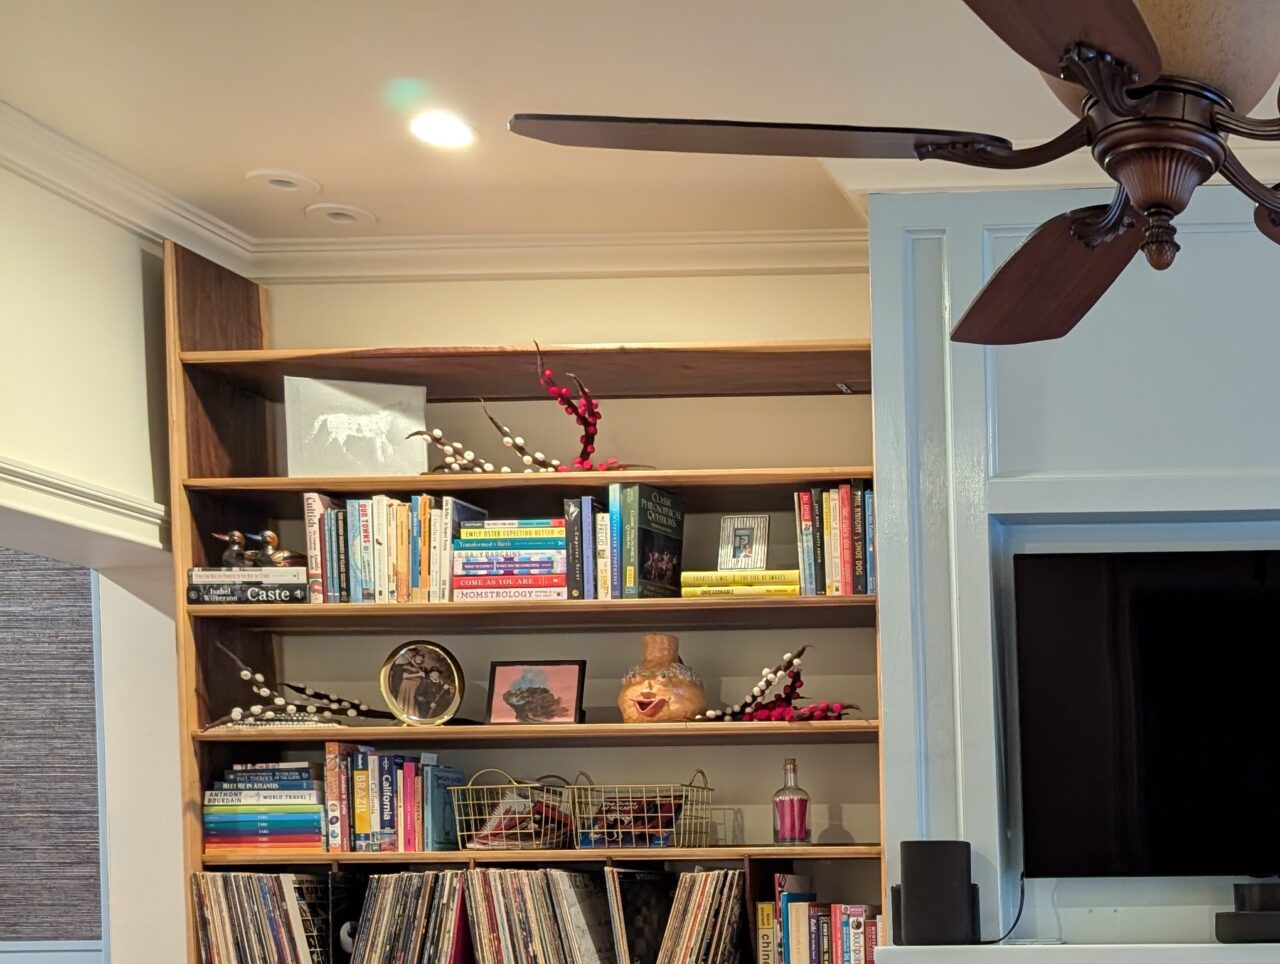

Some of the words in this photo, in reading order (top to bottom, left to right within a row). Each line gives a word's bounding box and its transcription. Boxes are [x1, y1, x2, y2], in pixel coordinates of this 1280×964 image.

[641, 498, 682, 520] PHILOSOPHICAL
[651, 492, 672, 505] CLASSIC
[305, 497, 317, 528] Cultish
[647, 510, 677, 528] QUESTIONS
[362, 519, 370, 544] TOWNS
[247, 587, 290, 601] Caste
[460, 590, 534, 599] MOMSTROLOGY
[356, 775, 367, 814] BRAZIL
[382, 774, 392, 820] California
